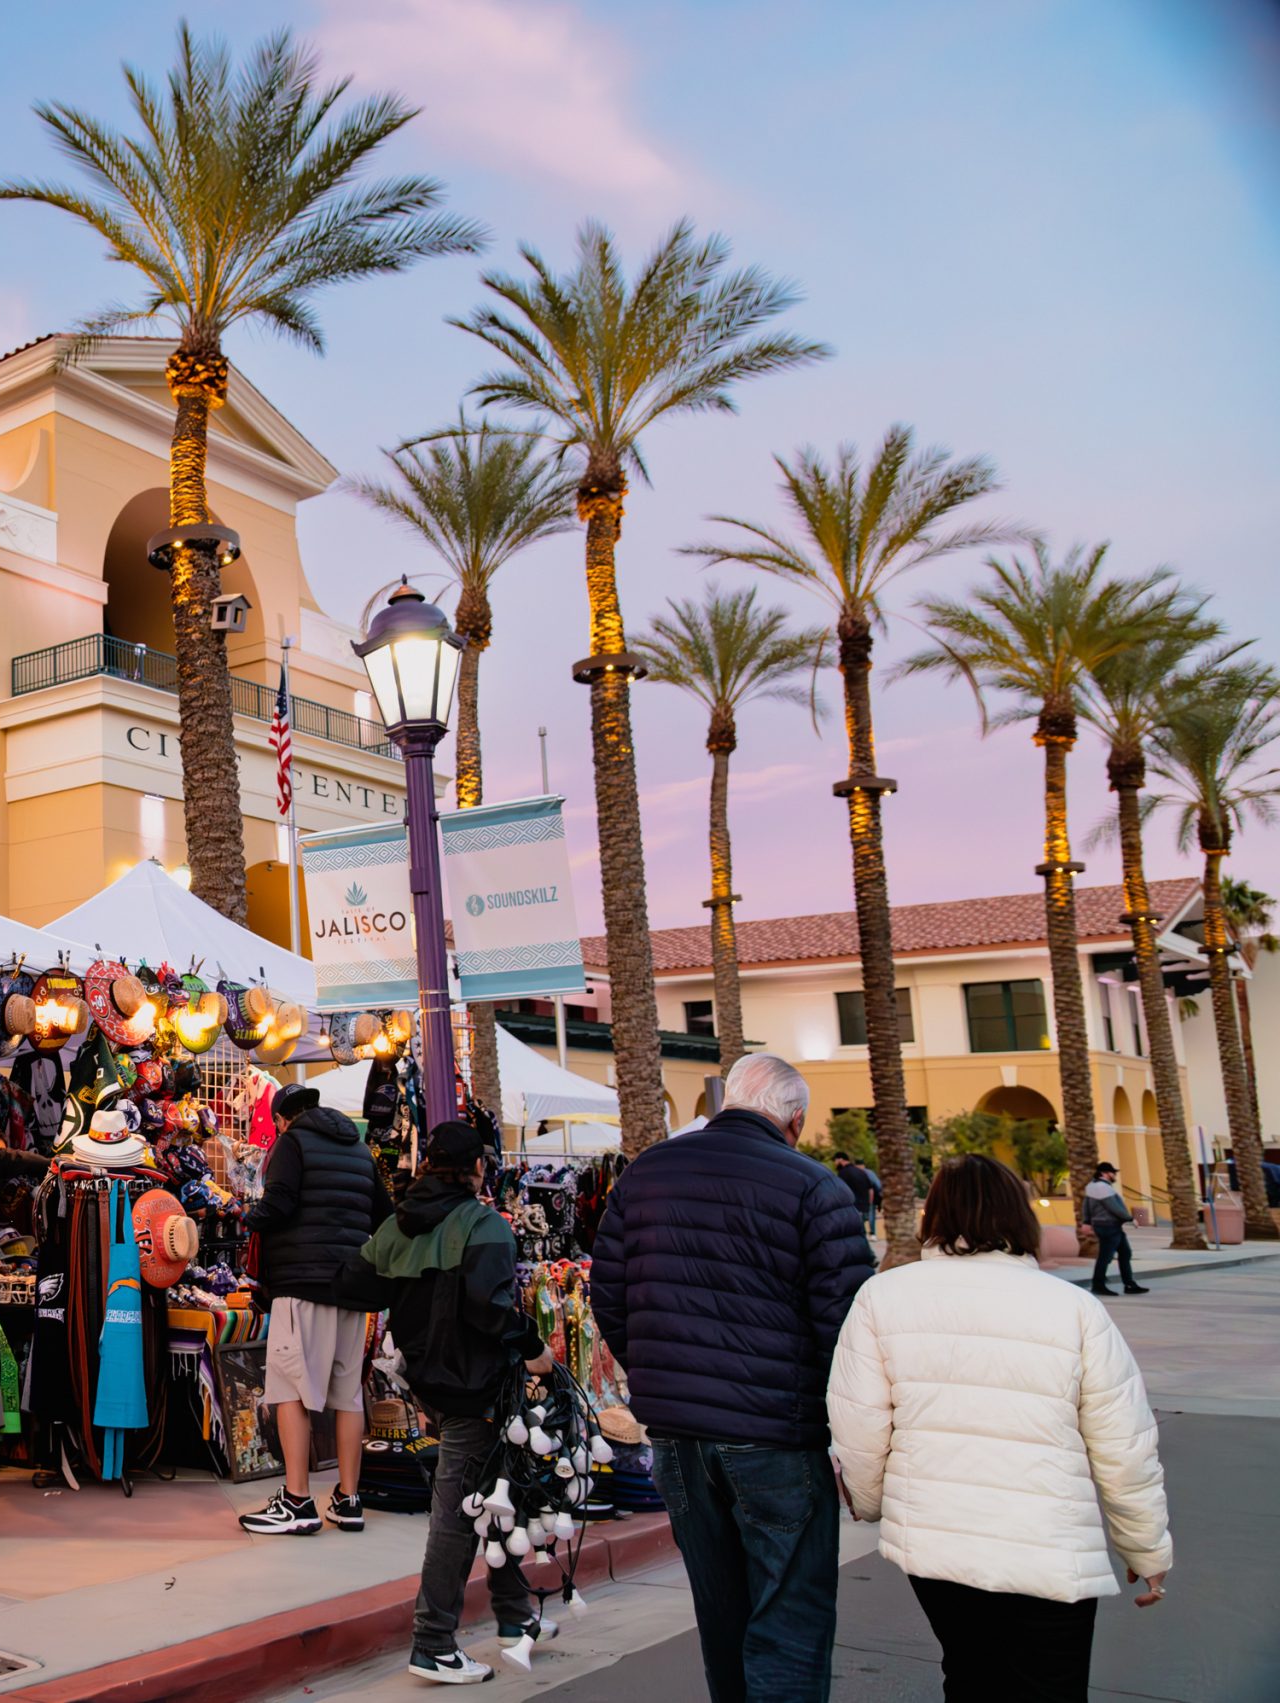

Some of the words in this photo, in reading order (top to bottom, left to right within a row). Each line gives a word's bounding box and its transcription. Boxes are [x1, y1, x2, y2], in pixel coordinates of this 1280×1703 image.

[291, 768, 409, 815] CENTE
[487, 885, 559, 910] SOUNDSKILZ
[315, 911, 406, 938] JALISCO
